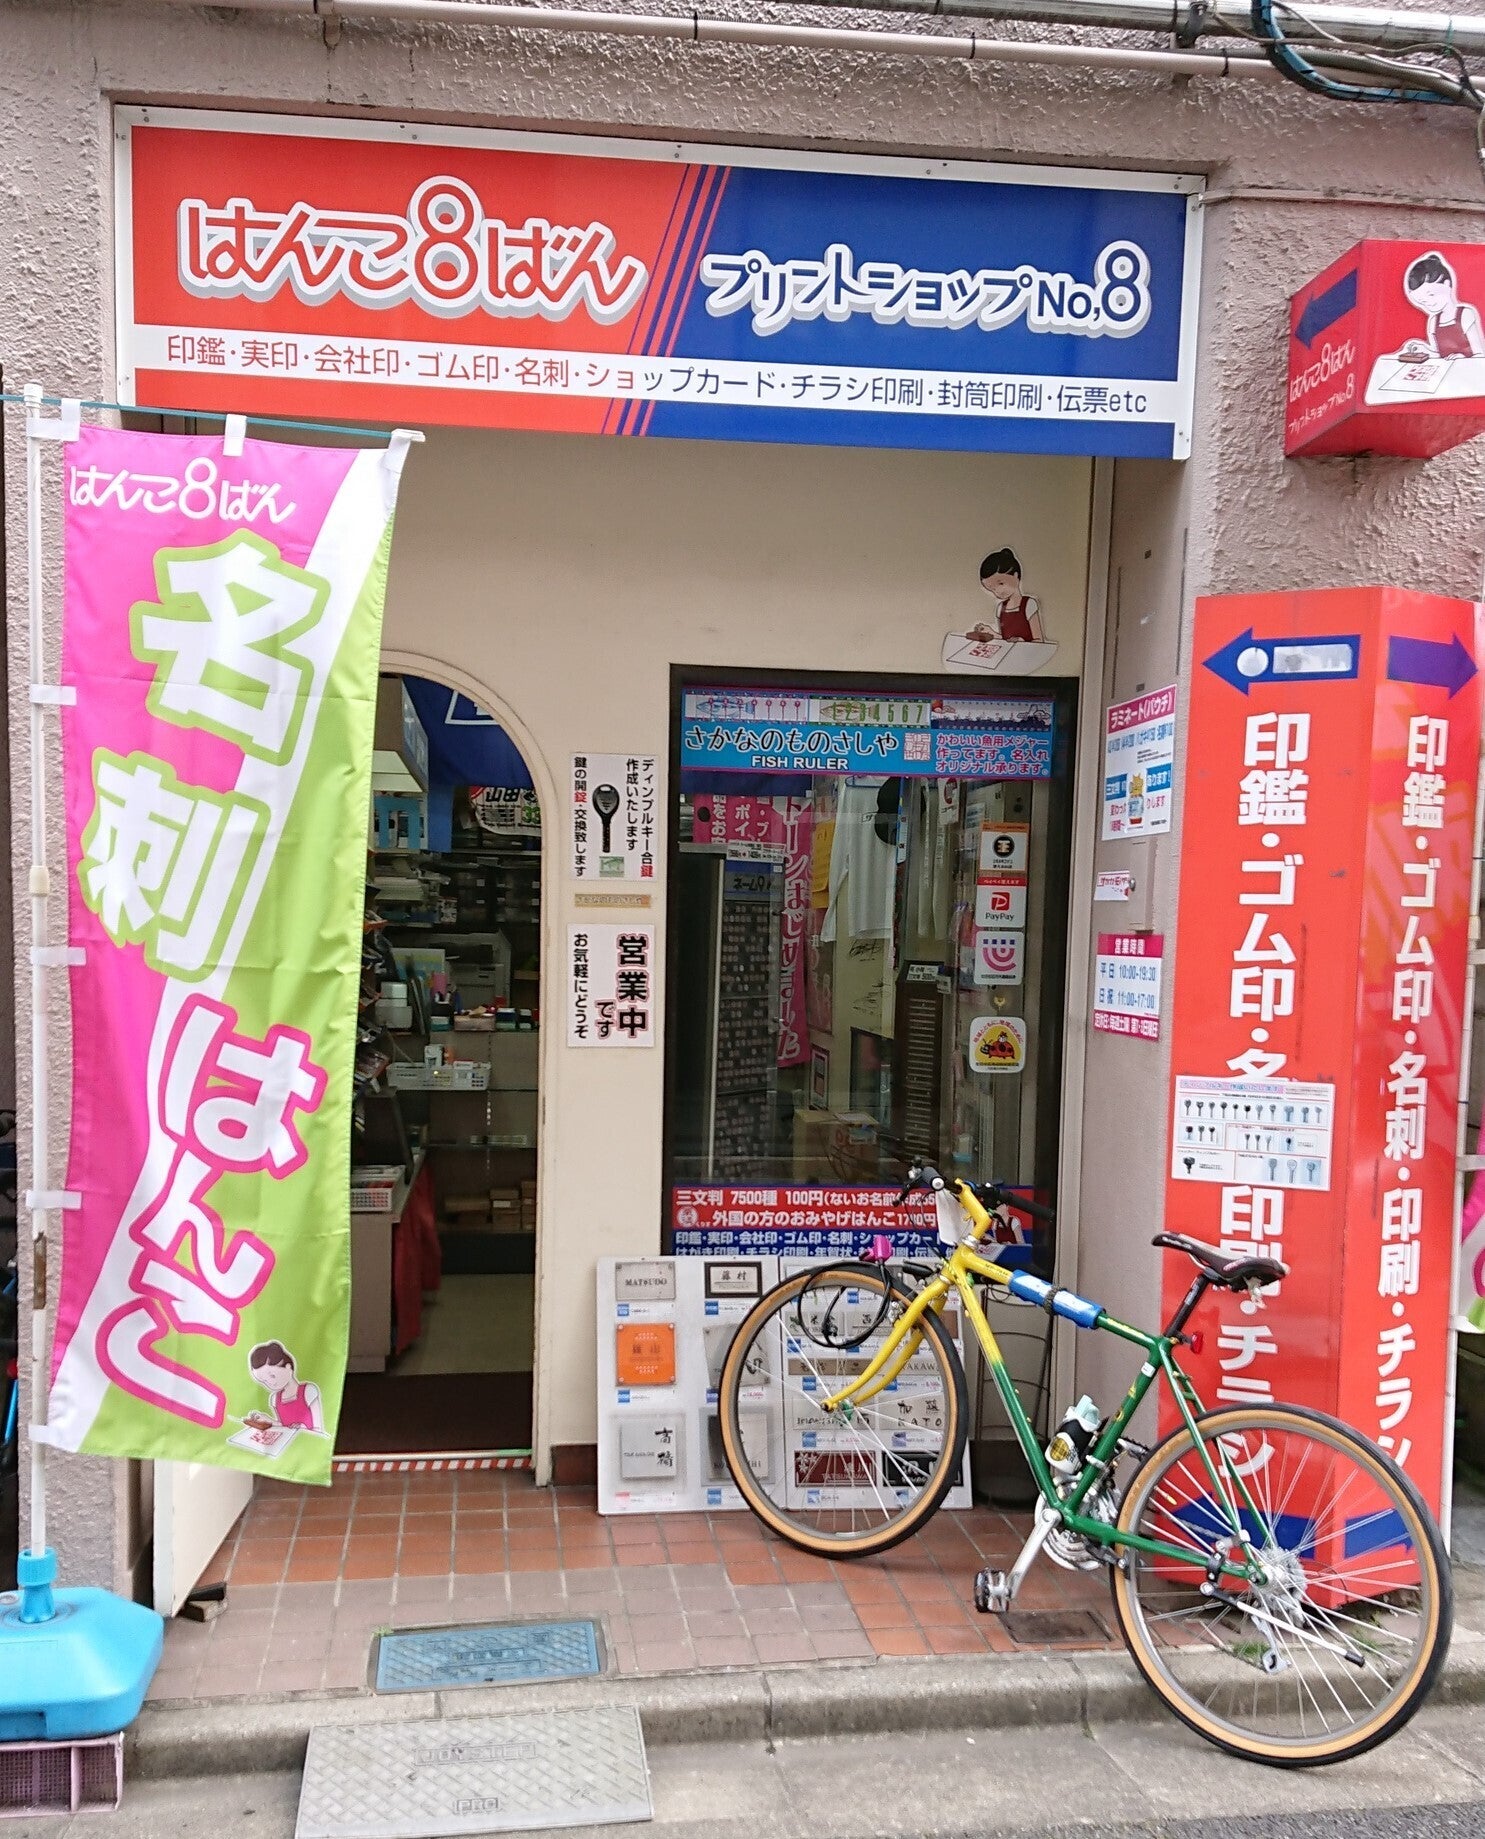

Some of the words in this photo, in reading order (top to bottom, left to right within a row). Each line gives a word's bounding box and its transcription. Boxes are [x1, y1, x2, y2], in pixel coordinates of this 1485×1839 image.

[178, 174, 648, 326] はんこ8ばん
[69, 457, 297, 524] はんこ8ばん
[78, 529, 331, 980] 名刺
[685, 725, 899, 757] さかなのものさしや
[752, 755, 788, 767] FISH
[793, 757, 848, 770] RULER
[626, 758, 639, 851] 作成いたします
[985, 912, 1015, 921] PayPay
[617, 934, 650, 1038] 営業中
[596, 1000, 616, 1039] です
[676, 1189, 724, 1206] 三文判
[730, 1190, 778, 1206] 7500種
